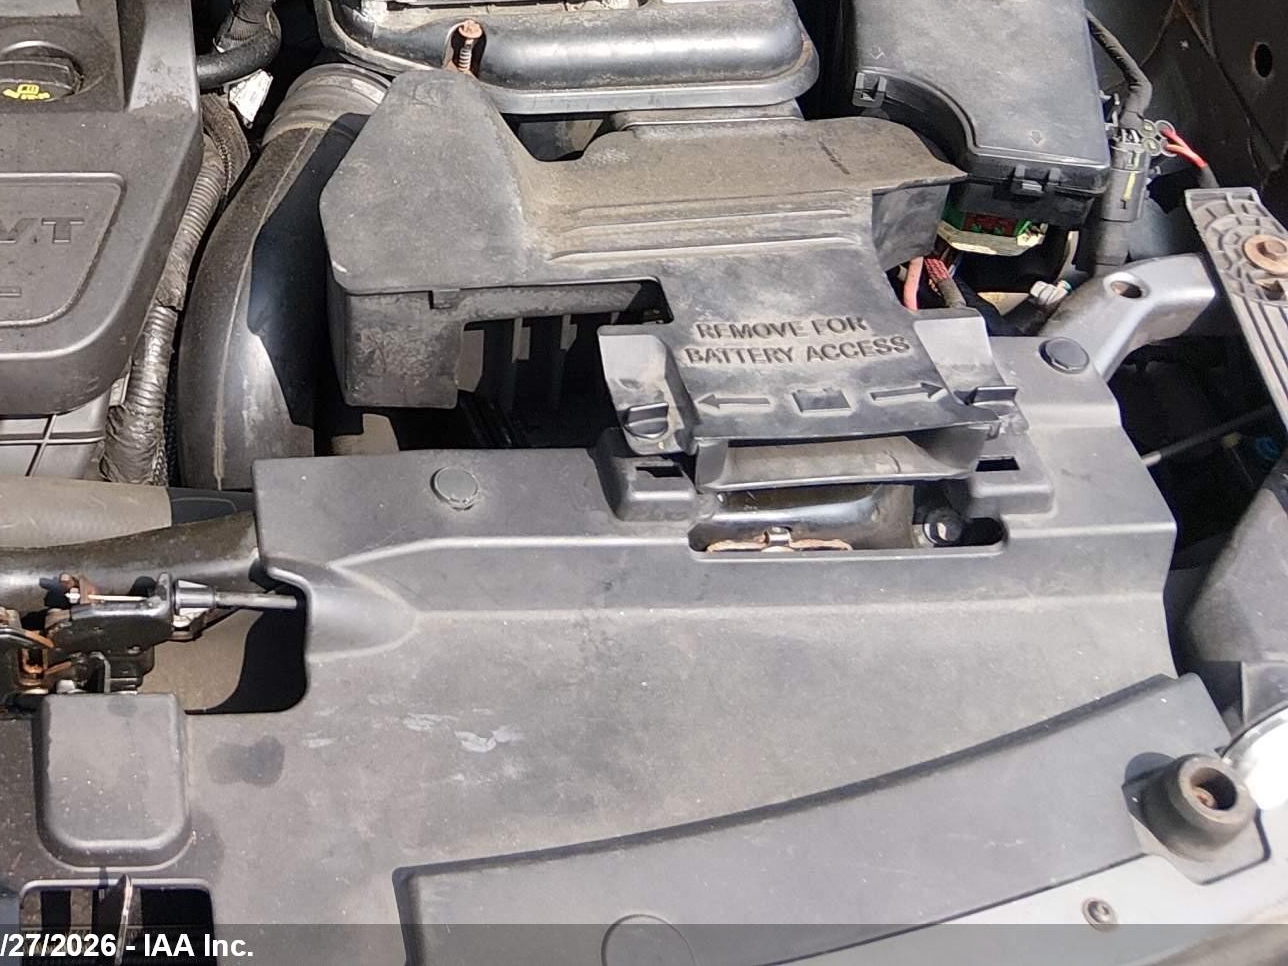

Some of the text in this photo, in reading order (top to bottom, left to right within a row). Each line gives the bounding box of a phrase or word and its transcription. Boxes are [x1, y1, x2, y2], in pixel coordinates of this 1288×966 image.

[695, 316, 869, 340] REMOVE FOR
[684, 335, 912, 365] BATTERY ACCESS
